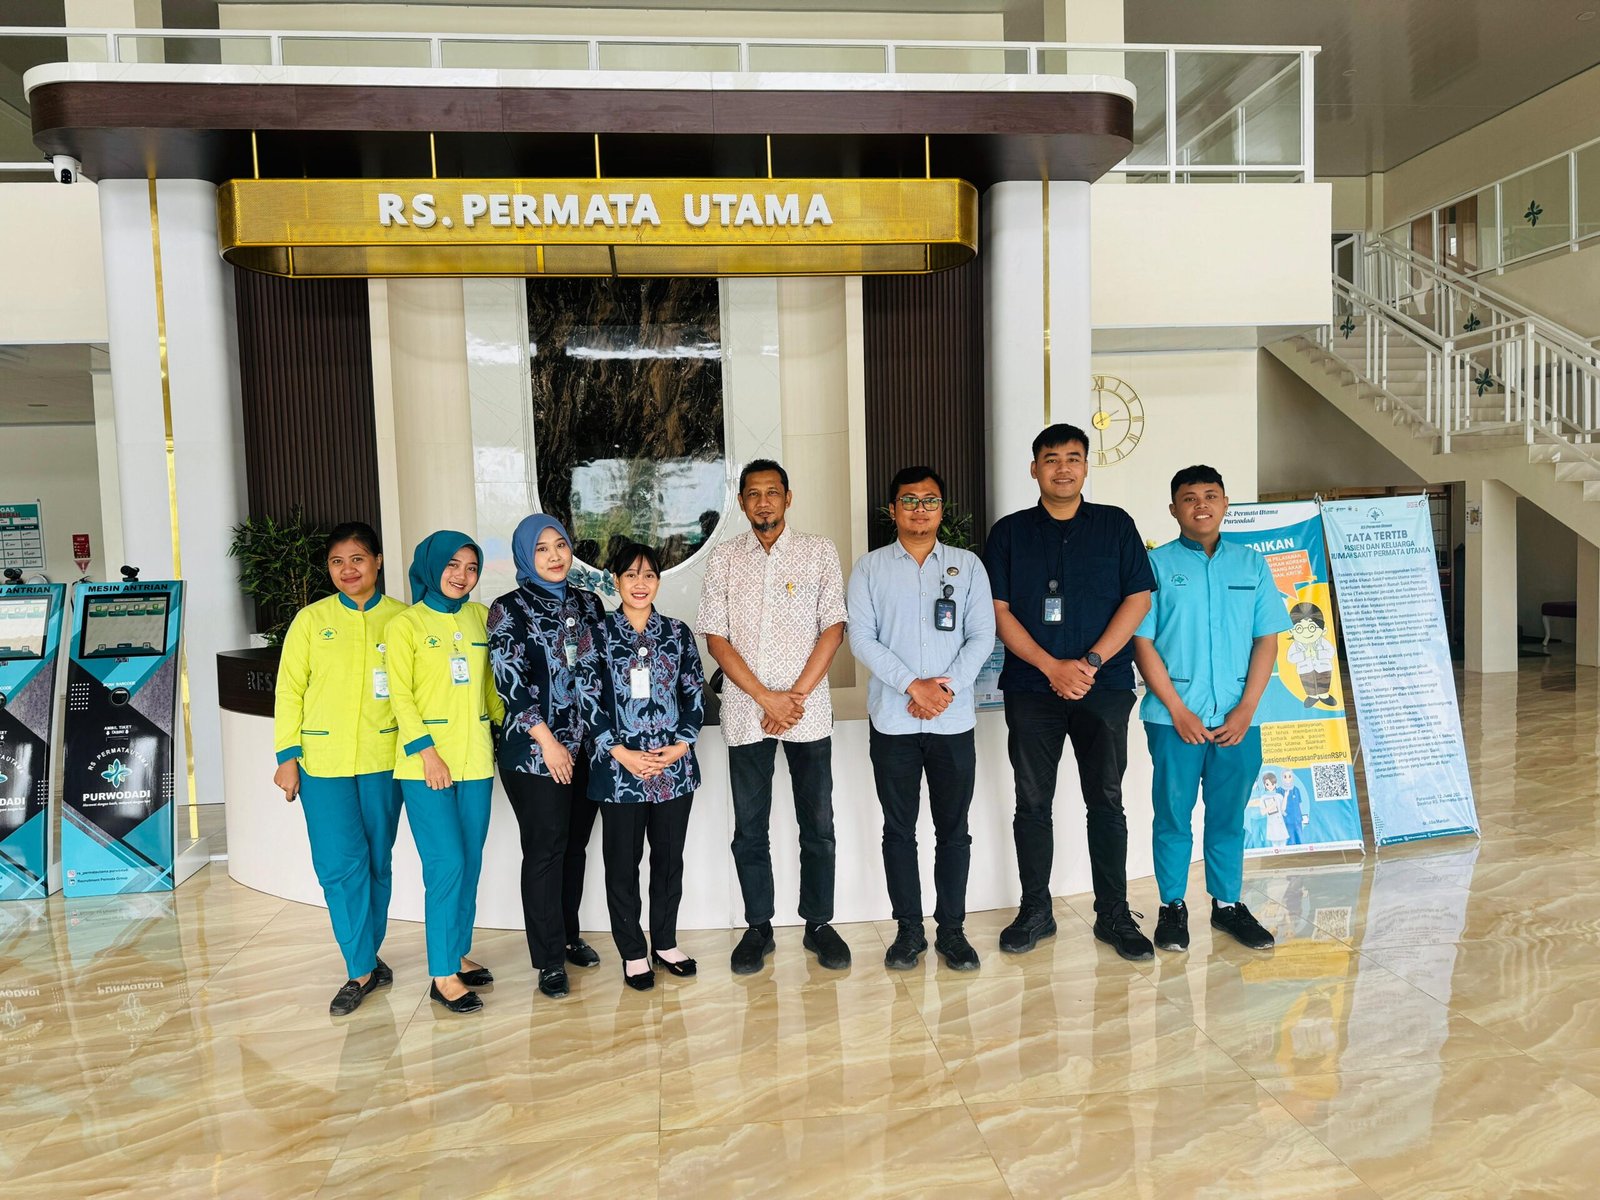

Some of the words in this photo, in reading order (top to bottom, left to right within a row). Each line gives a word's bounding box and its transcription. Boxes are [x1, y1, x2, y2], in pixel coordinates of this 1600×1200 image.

[378, 193, 454, 228] RS.
[462, 193, 661, 228] PERMATA
[683, 193, 834, 228] UTAMA
[1346, 531, 1372, 543] TATA
[1374, 529, 1408, 541] TERTIB
[1344, 543, 1365, 552] PASIEN
[1366, 542, 1380, 550] DAN
[1381, 540, 1415, 549] KELUARGA
[1354, 550, 1372, 559] SAKIT
[1374, 548, 1405, 557] PERMATA
[1406, 546, 1431, 555] UTAMA
[88, 585, 120, 593] MESIN
[122, 584, 168, 592] ANTRIAN
[83, 789, 151, 802] PURWODADI
